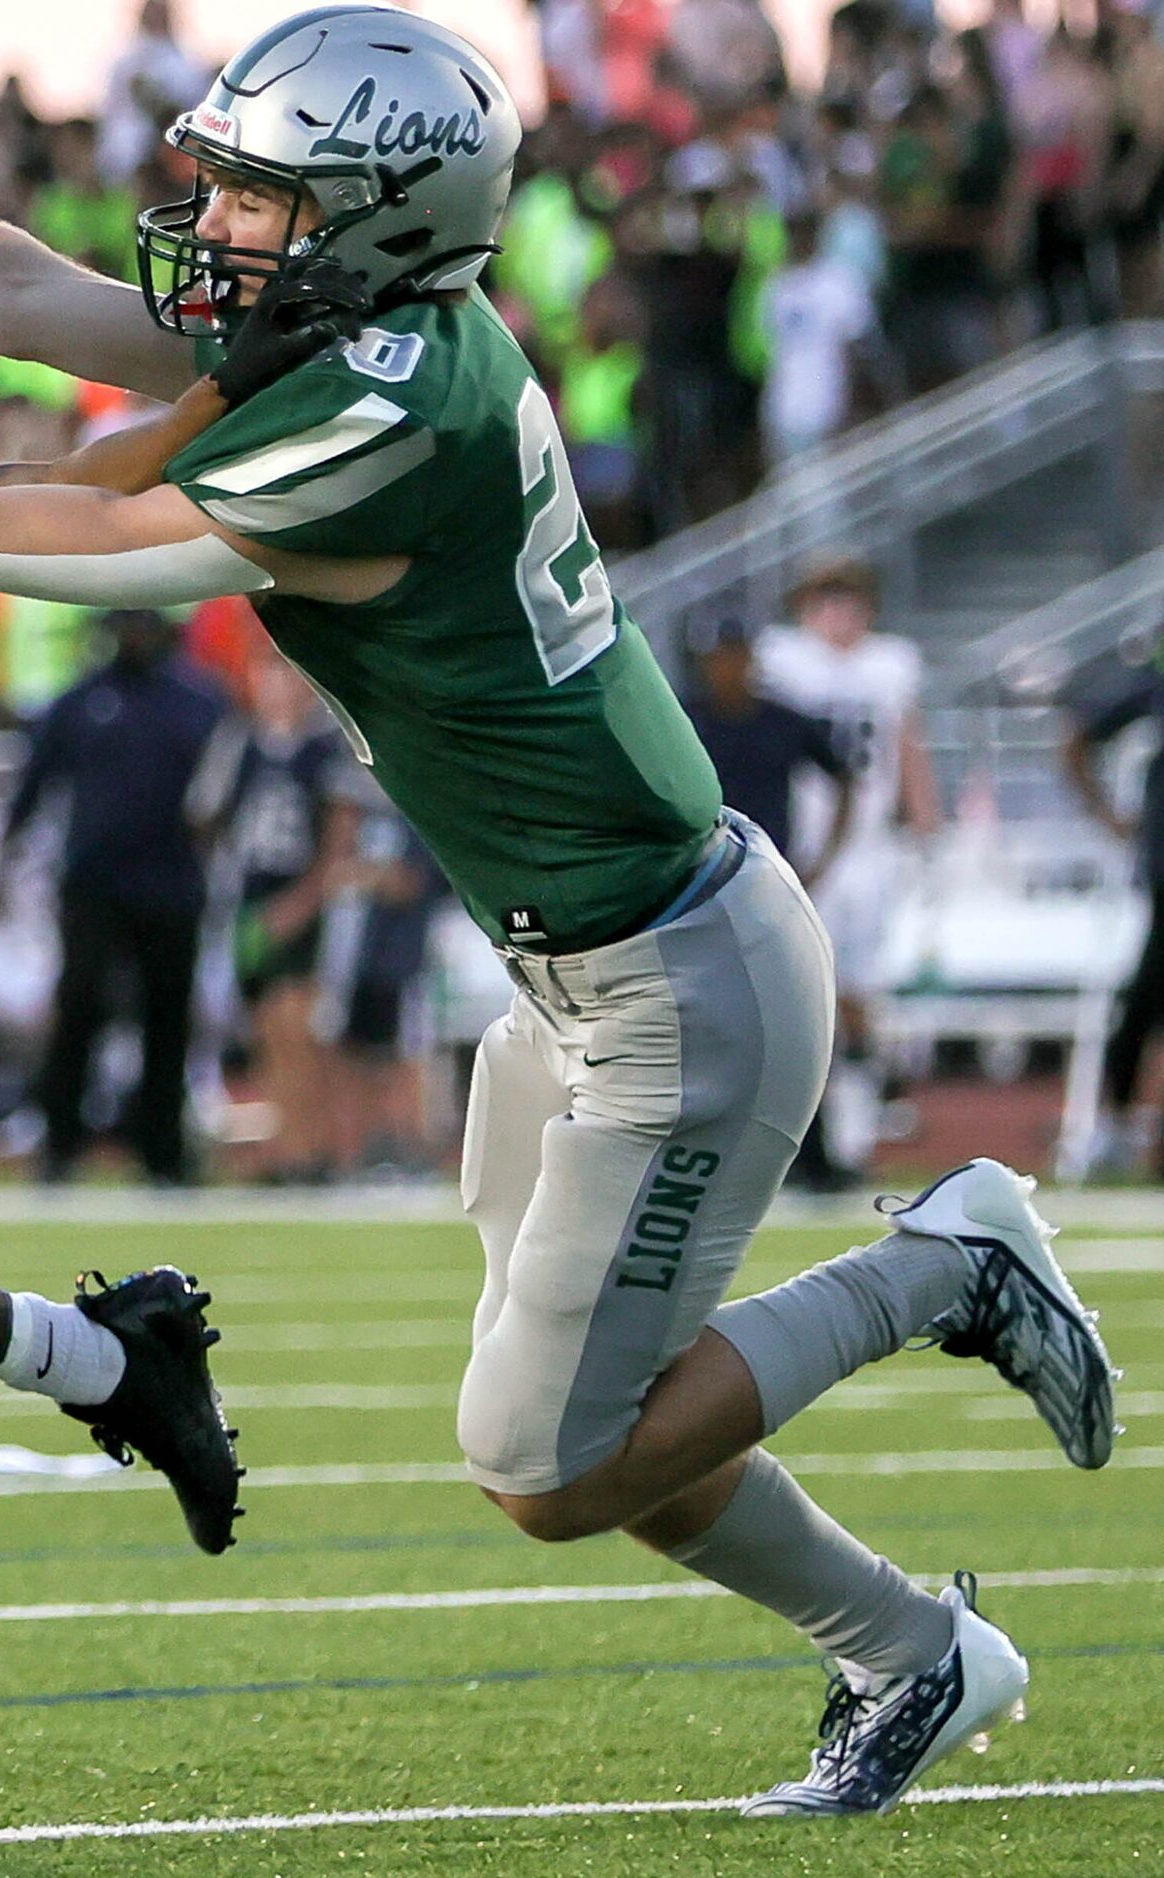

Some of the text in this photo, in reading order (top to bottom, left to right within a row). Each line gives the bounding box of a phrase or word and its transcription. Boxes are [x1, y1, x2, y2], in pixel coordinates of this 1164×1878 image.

[309, 76, 487, 158] Lions
[512, 911, 530, 928] M
[615, 1146, 721, 1291] LIONS
